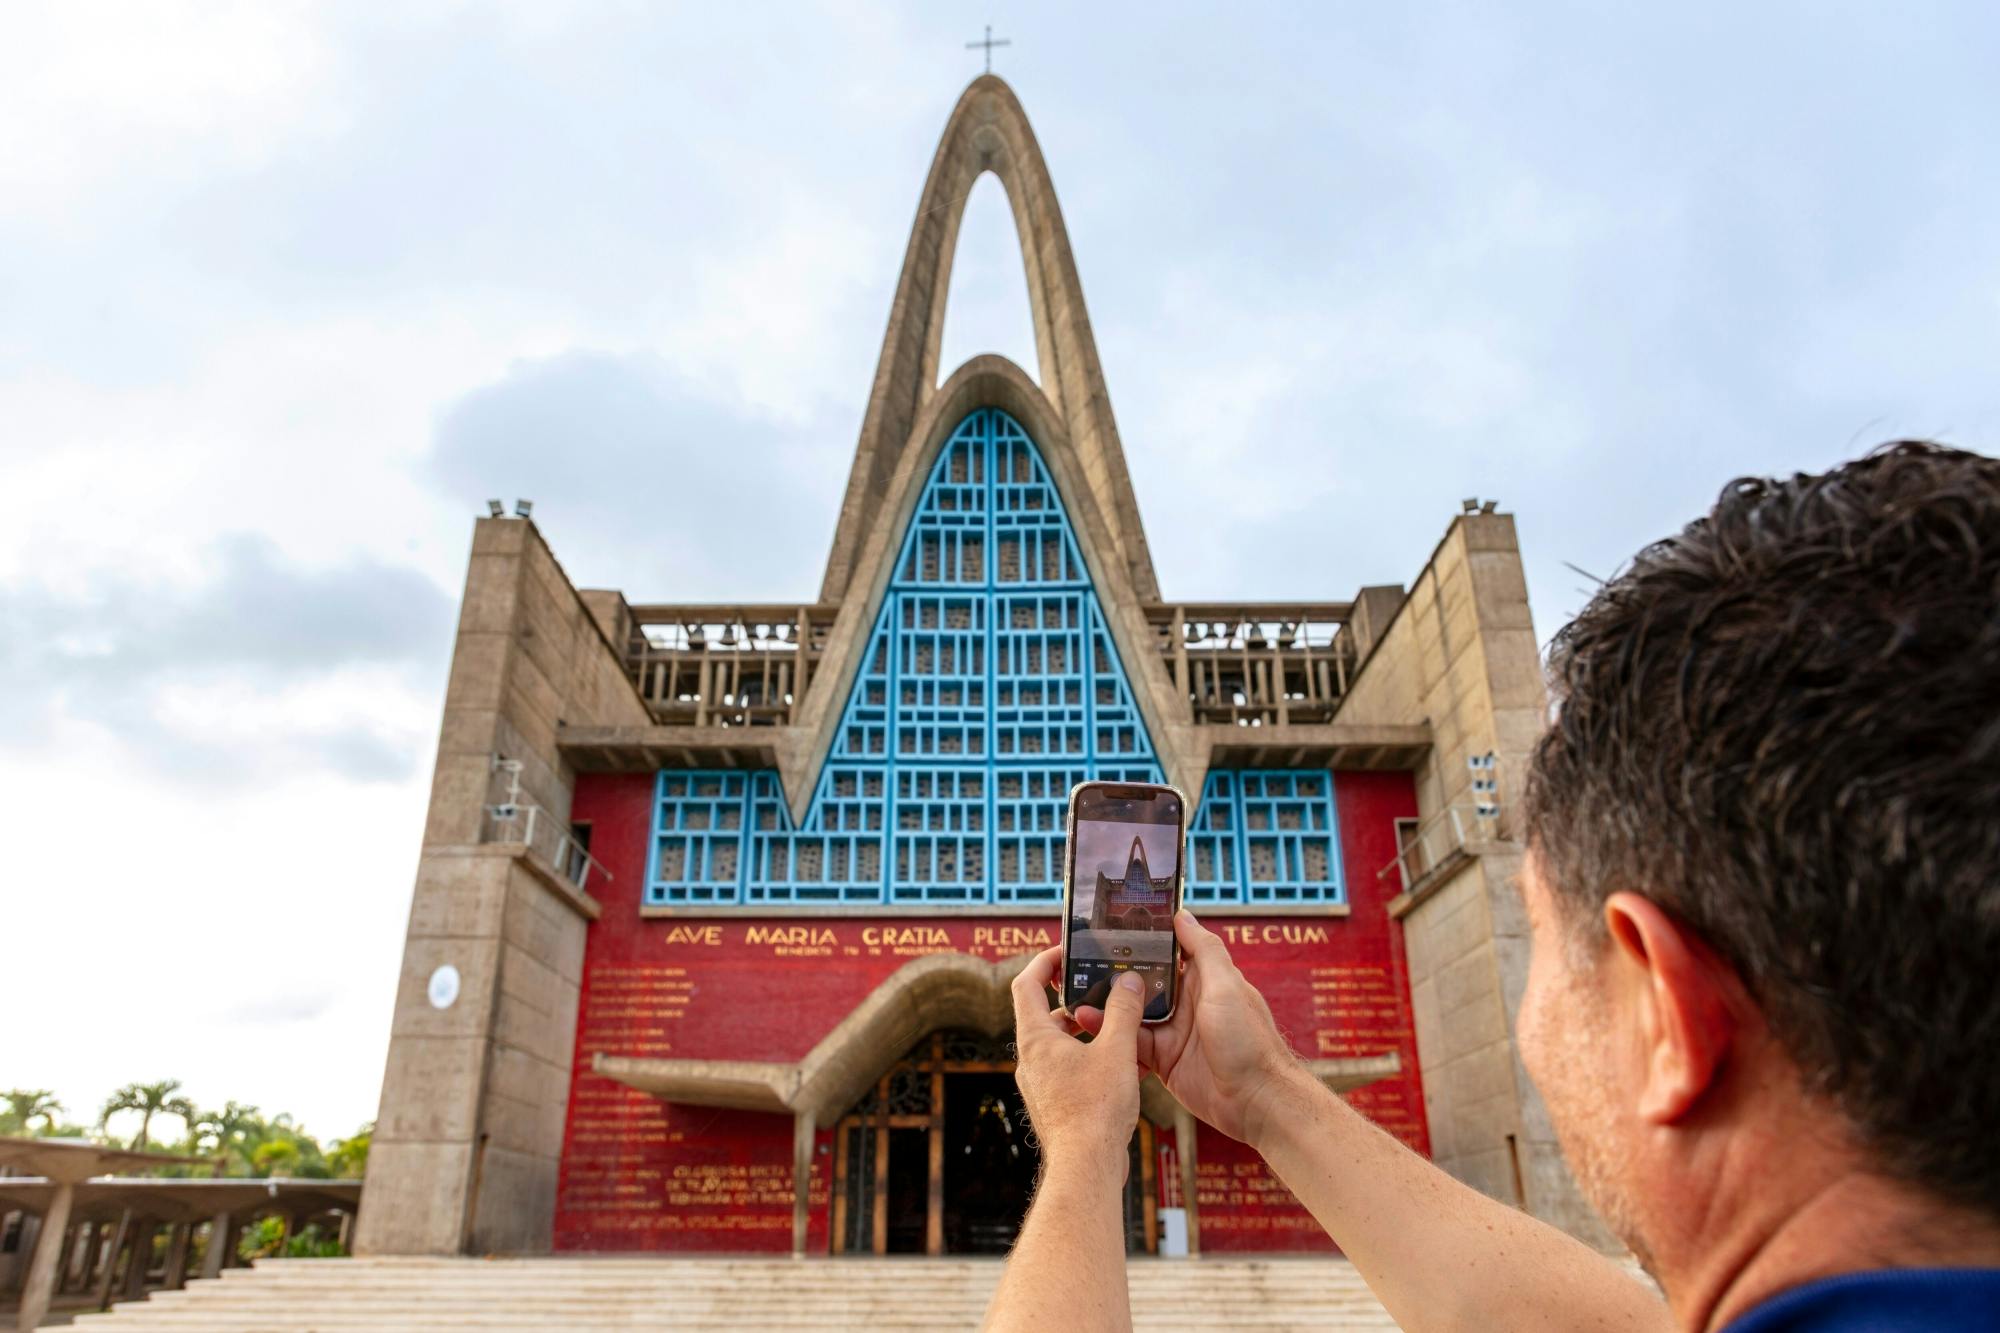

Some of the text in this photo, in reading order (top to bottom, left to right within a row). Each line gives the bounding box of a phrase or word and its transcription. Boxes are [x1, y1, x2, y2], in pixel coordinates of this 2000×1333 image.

[665, 924, 1330, 946] AVE MARIA GRATIA PLENA TECUM
